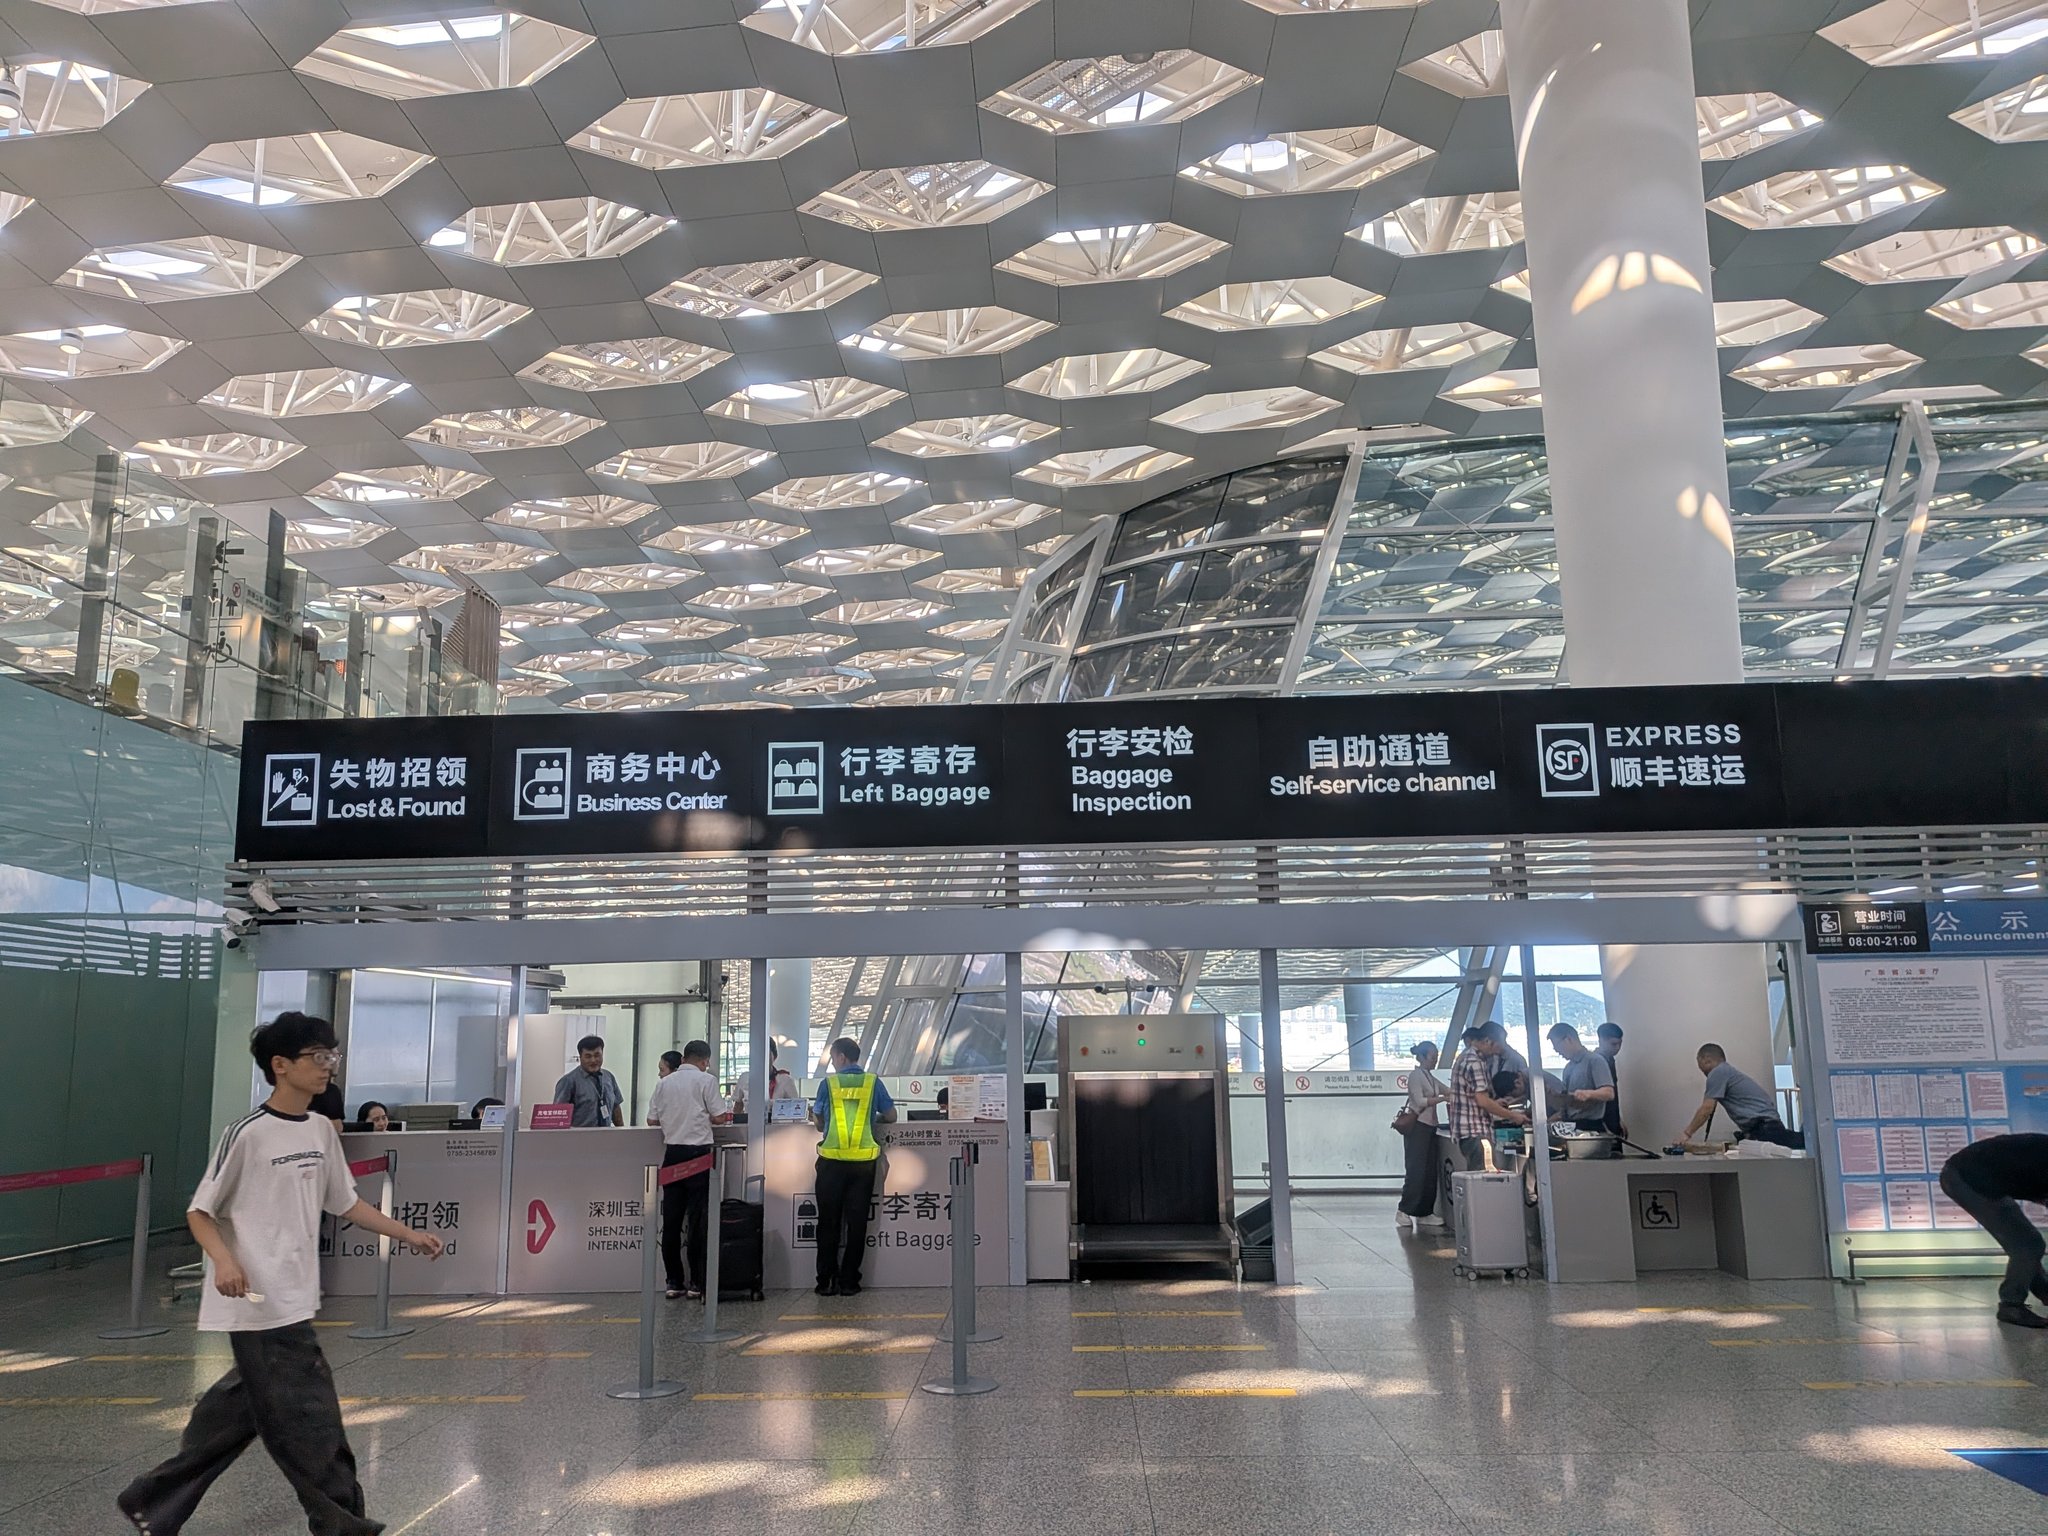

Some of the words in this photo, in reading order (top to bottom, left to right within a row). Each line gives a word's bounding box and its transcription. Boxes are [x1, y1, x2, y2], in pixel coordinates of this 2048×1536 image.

[1066, 725, 1194, 758] 行李安检
[1605, 724, 1741, 747] EXPRESS
[839, 744, 976, 777] 行李寄存
[1308, 732, 1452, 769] 自助通道
[329, 756, 467, 790] 失物招领
[585, 750, 722, 784] 商务中心
[1071, 766, 1173, 789] Baggage
[1610, 754, 1746, 788] 顺丰速运
[1269, 773, 1400, 796] Self-service
[1405, 770, 1496, 793] channel
[576, 793, 661, 813] Business
[667, 791, 728, 811] Center
[839, 783, 884, 803] Left
[891, 783, 991, 807] Baggage
[1072, 791, 1192, 816] Inspection
[327, 795, 466, 819] Lost&Found
[1854, 910, 1906, 924] 营业时间
[1931, 911, 2028, 931] 公示
[1848, 936, 1918, 947] 08:00-21:00
[899, 1130, 942, 1138] 24小时营业
[589, 1201, 645, 1218] 深圳宝
[588, 1240, 642, 1250] INTERNAT
[865, 1231, 890, 1247] eft
[896, 1231, 982, 1251] Baggae
